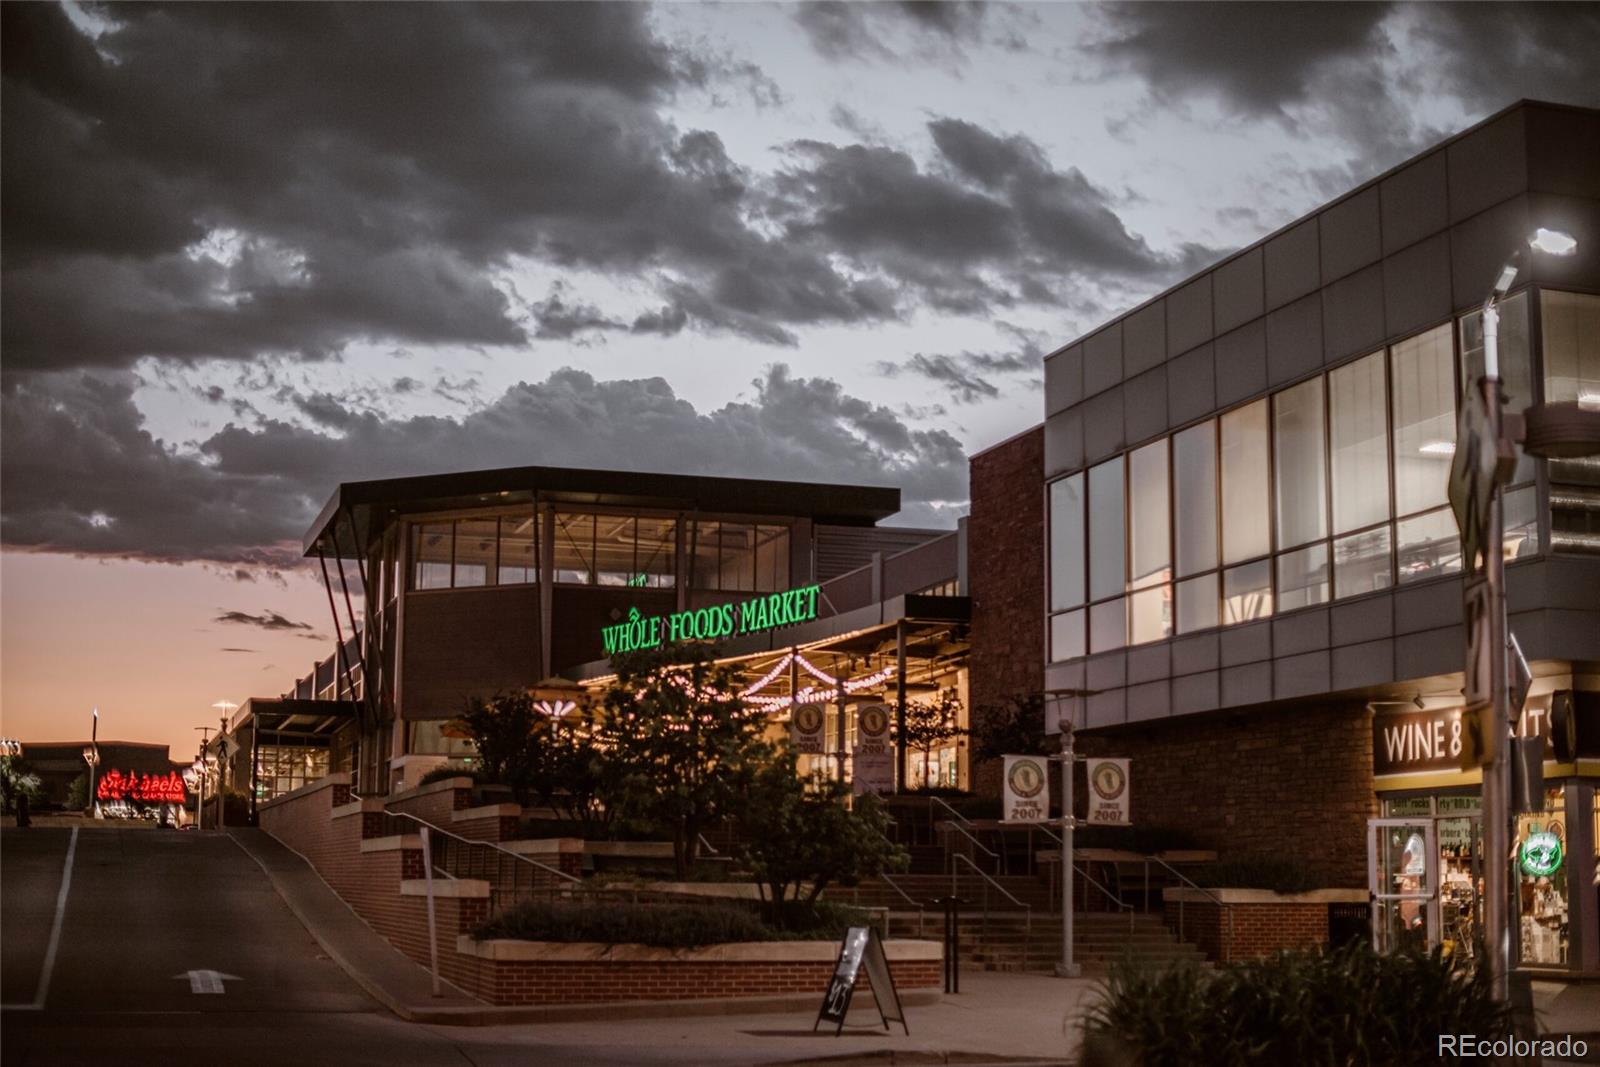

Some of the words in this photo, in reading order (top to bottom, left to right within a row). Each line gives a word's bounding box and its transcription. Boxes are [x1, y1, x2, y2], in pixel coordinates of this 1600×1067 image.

[601, 610, 661, 655] WHOLE
[669, 603, 735, 642] FOODS
[740, 584, 820, 633] MARKET
[1384, 720, 1446, 763] WINE
[1012, 808, 1042, 819] 2007
[1094, 811, 1124, 822] 2007
